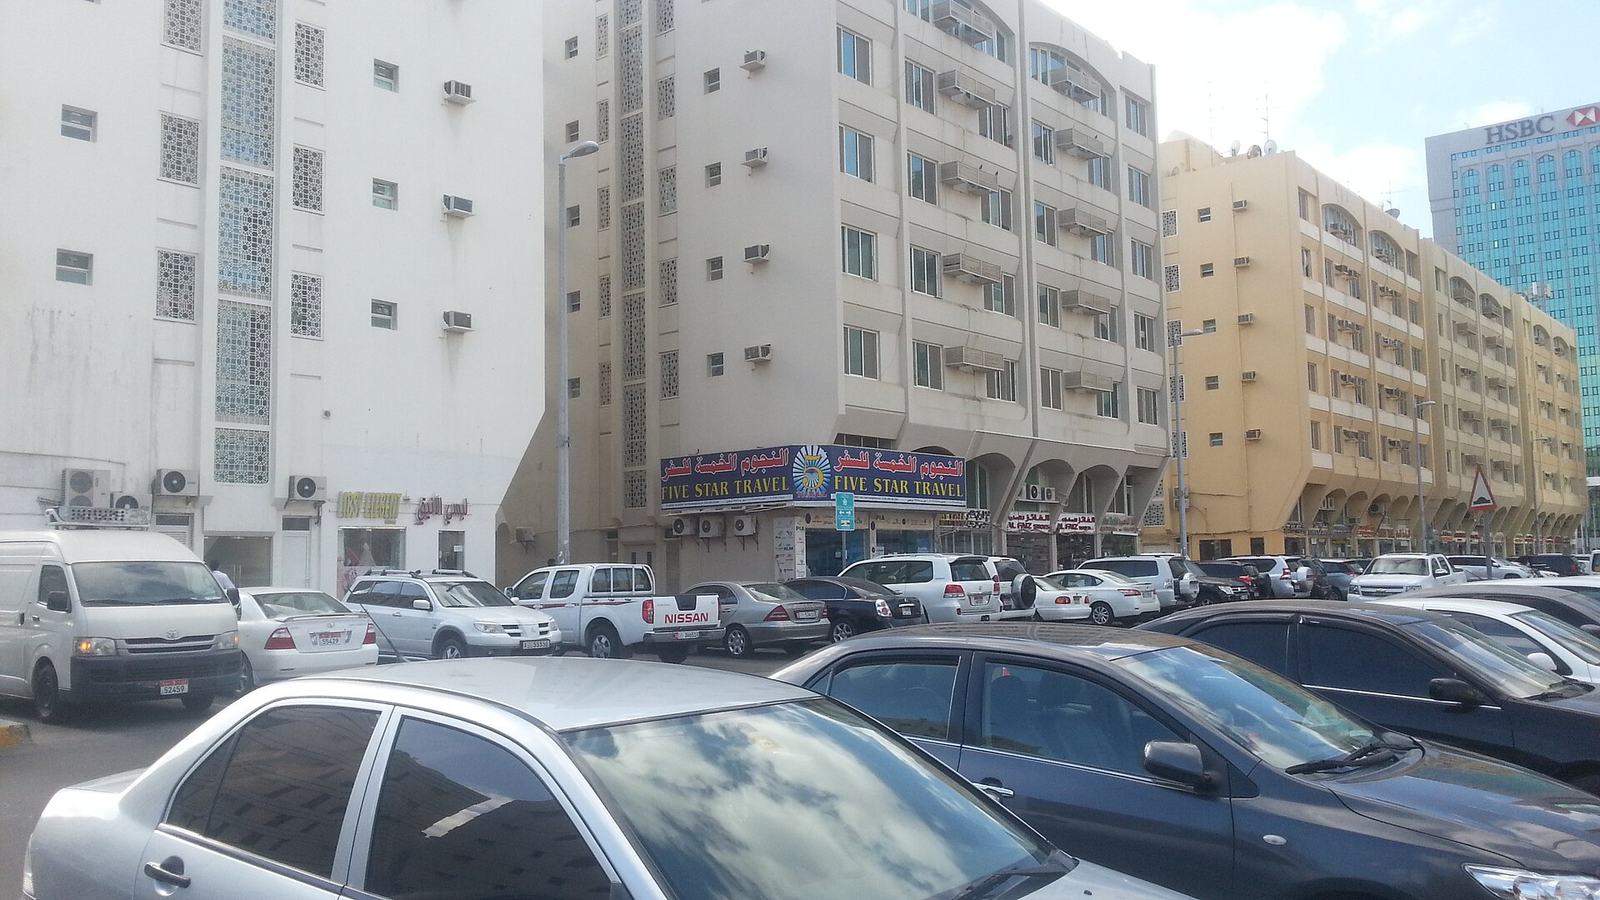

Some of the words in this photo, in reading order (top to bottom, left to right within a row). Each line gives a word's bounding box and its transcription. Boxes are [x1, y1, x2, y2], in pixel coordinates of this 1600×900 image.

[1485, 115, 1555, 145] HSBC
[660, 457, 692, 482] للسفر
[694, 452, 738, 475] الخمسة
[740, 447, 790, 477] النجوم
[833, 449, 870, 472] للسفر
[873, 451, 917, 474] الخمسة
[919, 460, 963, 481] النجوم
[661, 484, 690, 500] FIVE
[694, 481, 729, 498] STAR
[734, 476, 790, 495] TRAVEL
[834, 475, 868, 492] FIVE
[873, 477, 910, 495] STAR
[914, 481, 964, 497] TRAVEL
[664, 612, 709, 624] NISSAN
[163, 685, 186, 694] 52459
